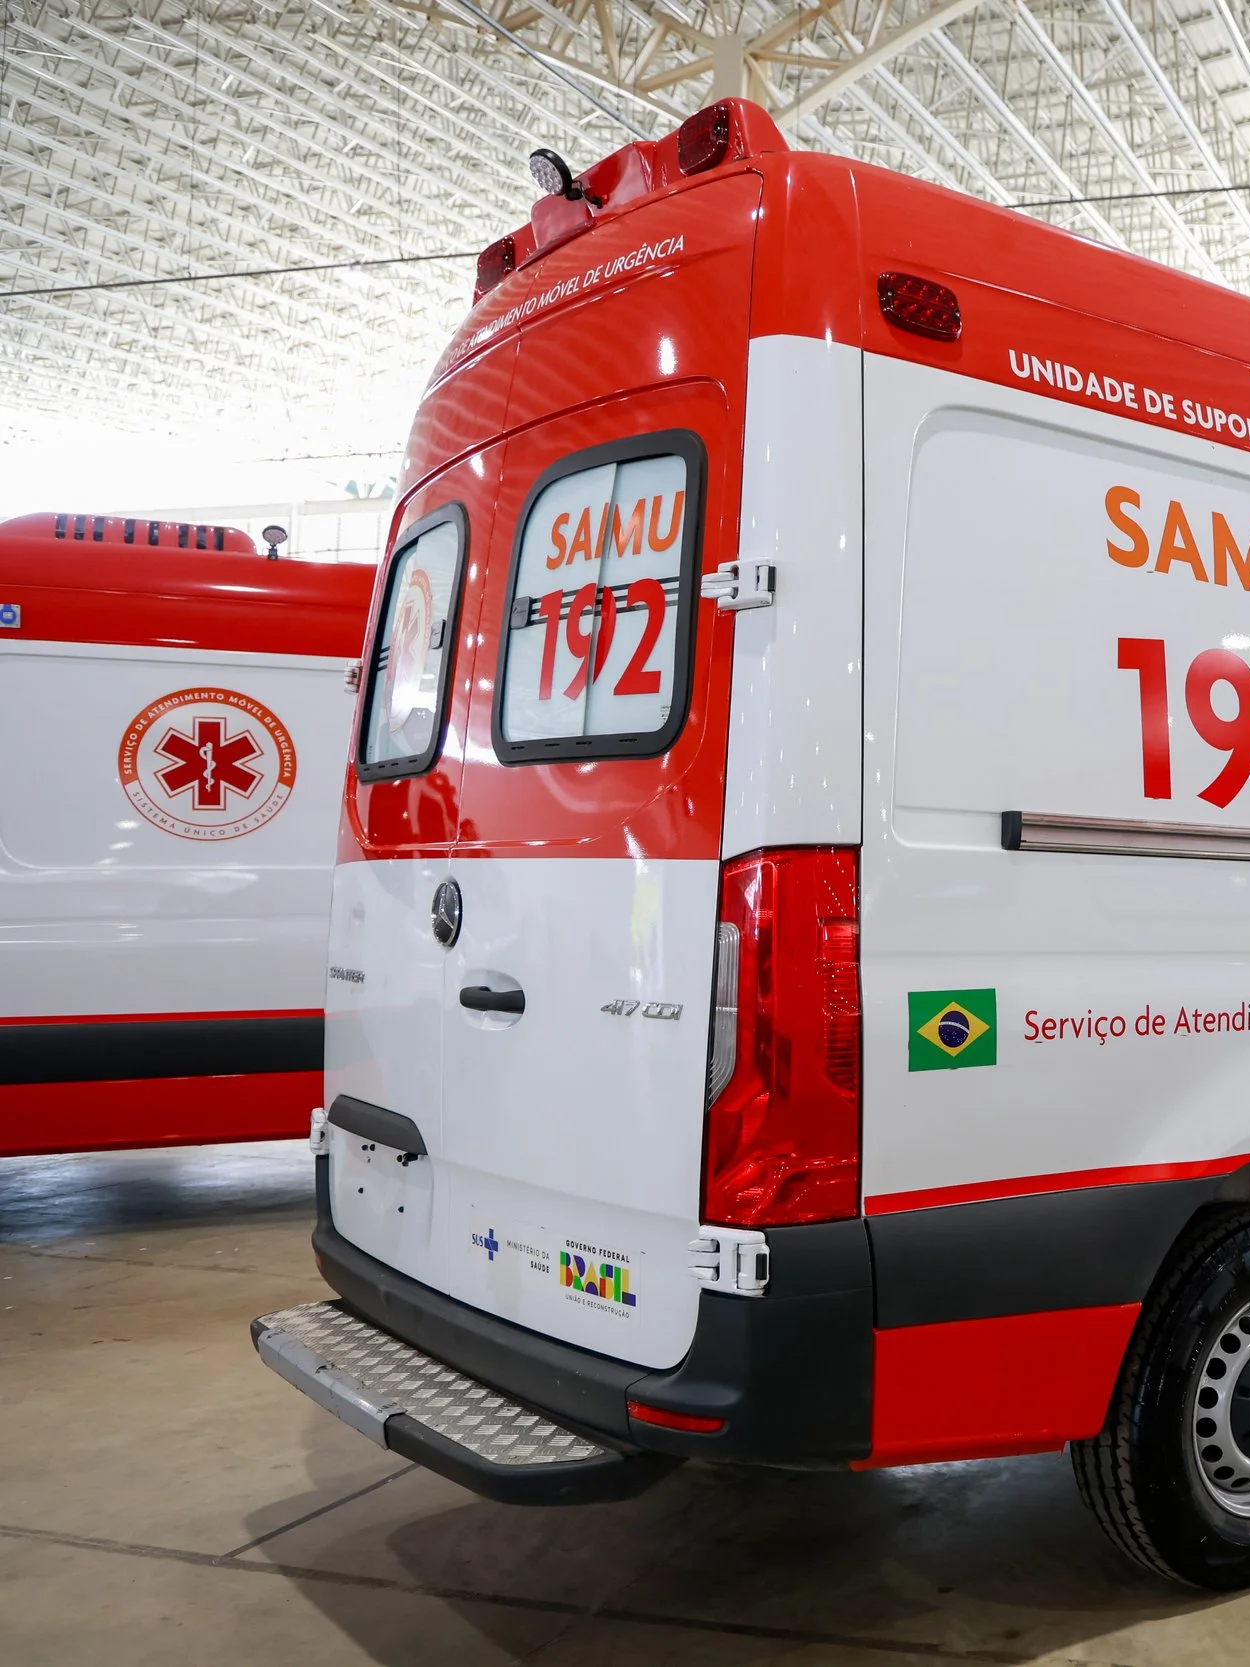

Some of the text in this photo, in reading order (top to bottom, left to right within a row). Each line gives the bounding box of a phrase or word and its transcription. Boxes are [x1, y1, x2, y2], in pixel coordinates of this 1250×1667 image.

[538, 277, 580, 308] MÓVEL
[583, 265, 603, 287] DE
[604, 234, 685, 279] URGÊNCIA
[1008, 348, 1139, 409] UNIDADE
[1143, 387, 1178, 420] DE
[546, 490, 685, 570] SAMU
[538, 578, 666, 701] 192
[124, 691, 292, 778] SERVIÇO DE ATENDIMENTO MÓVEL DE URGÊNCIA
[132, 791, 283, 837] SISTEMA ÚNICO DE SAÚDE
[600, 999, 684, 1021] 417 CDI
[1024, 1009, 1126, 1045] Serviço
[1134, 1004, 1166, 1036] de
[471, 1233, 484, 1247] SUS
[506, 1240, 550, 1260] MINISTÉRIO DA
[565, 1239, 630, 1263] GOVERNO FEDERAL
[530, 1260, 550, 1274] SAÚDE
[559, 1250, 637, 1307] BRASIL
